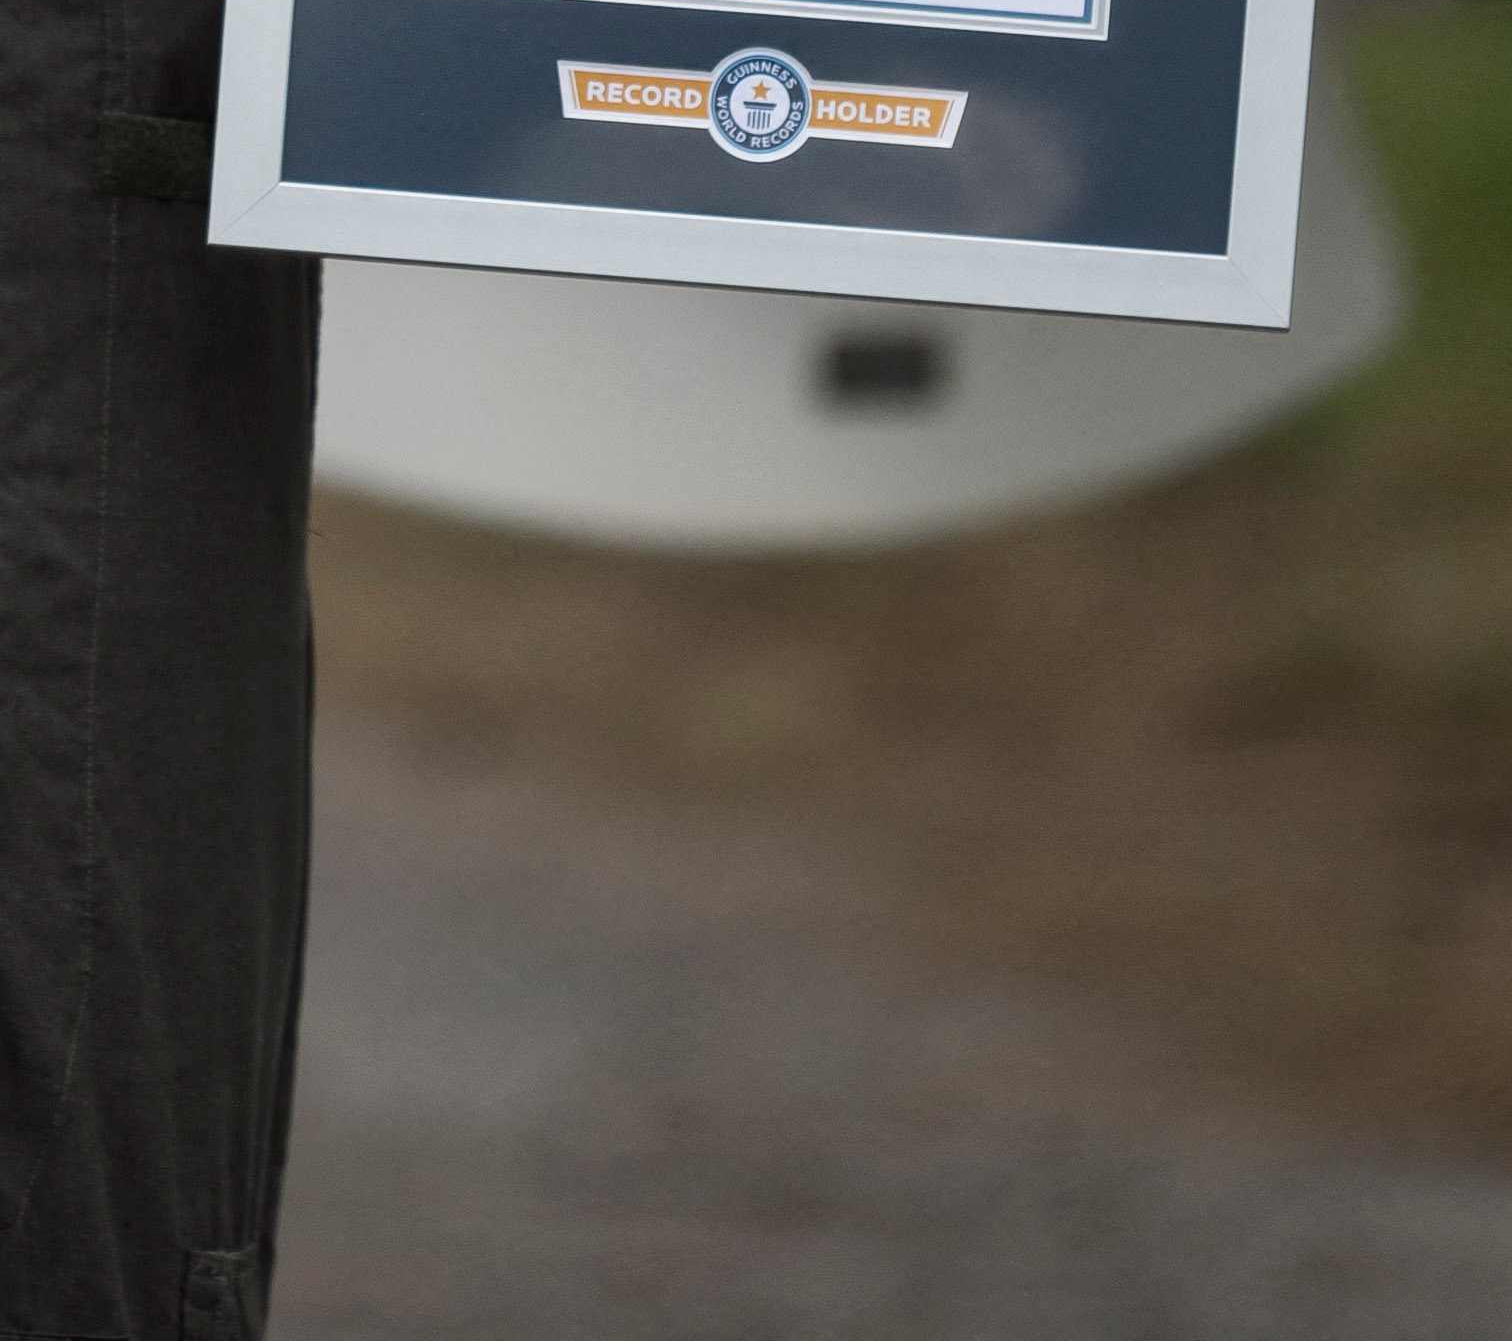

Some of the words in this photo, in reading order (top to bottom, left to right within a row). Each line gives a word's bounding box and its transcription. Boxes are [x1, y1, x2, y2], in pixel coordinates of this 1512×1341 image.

[726, 61, 796, 90] GUINNESS
[586, 81, 702, 110] RECORD
[816, 100, 931, 128] HOLDER
[717, 96, 746, 143] WORLD
[750, 101, 804, 149] RECORDS
